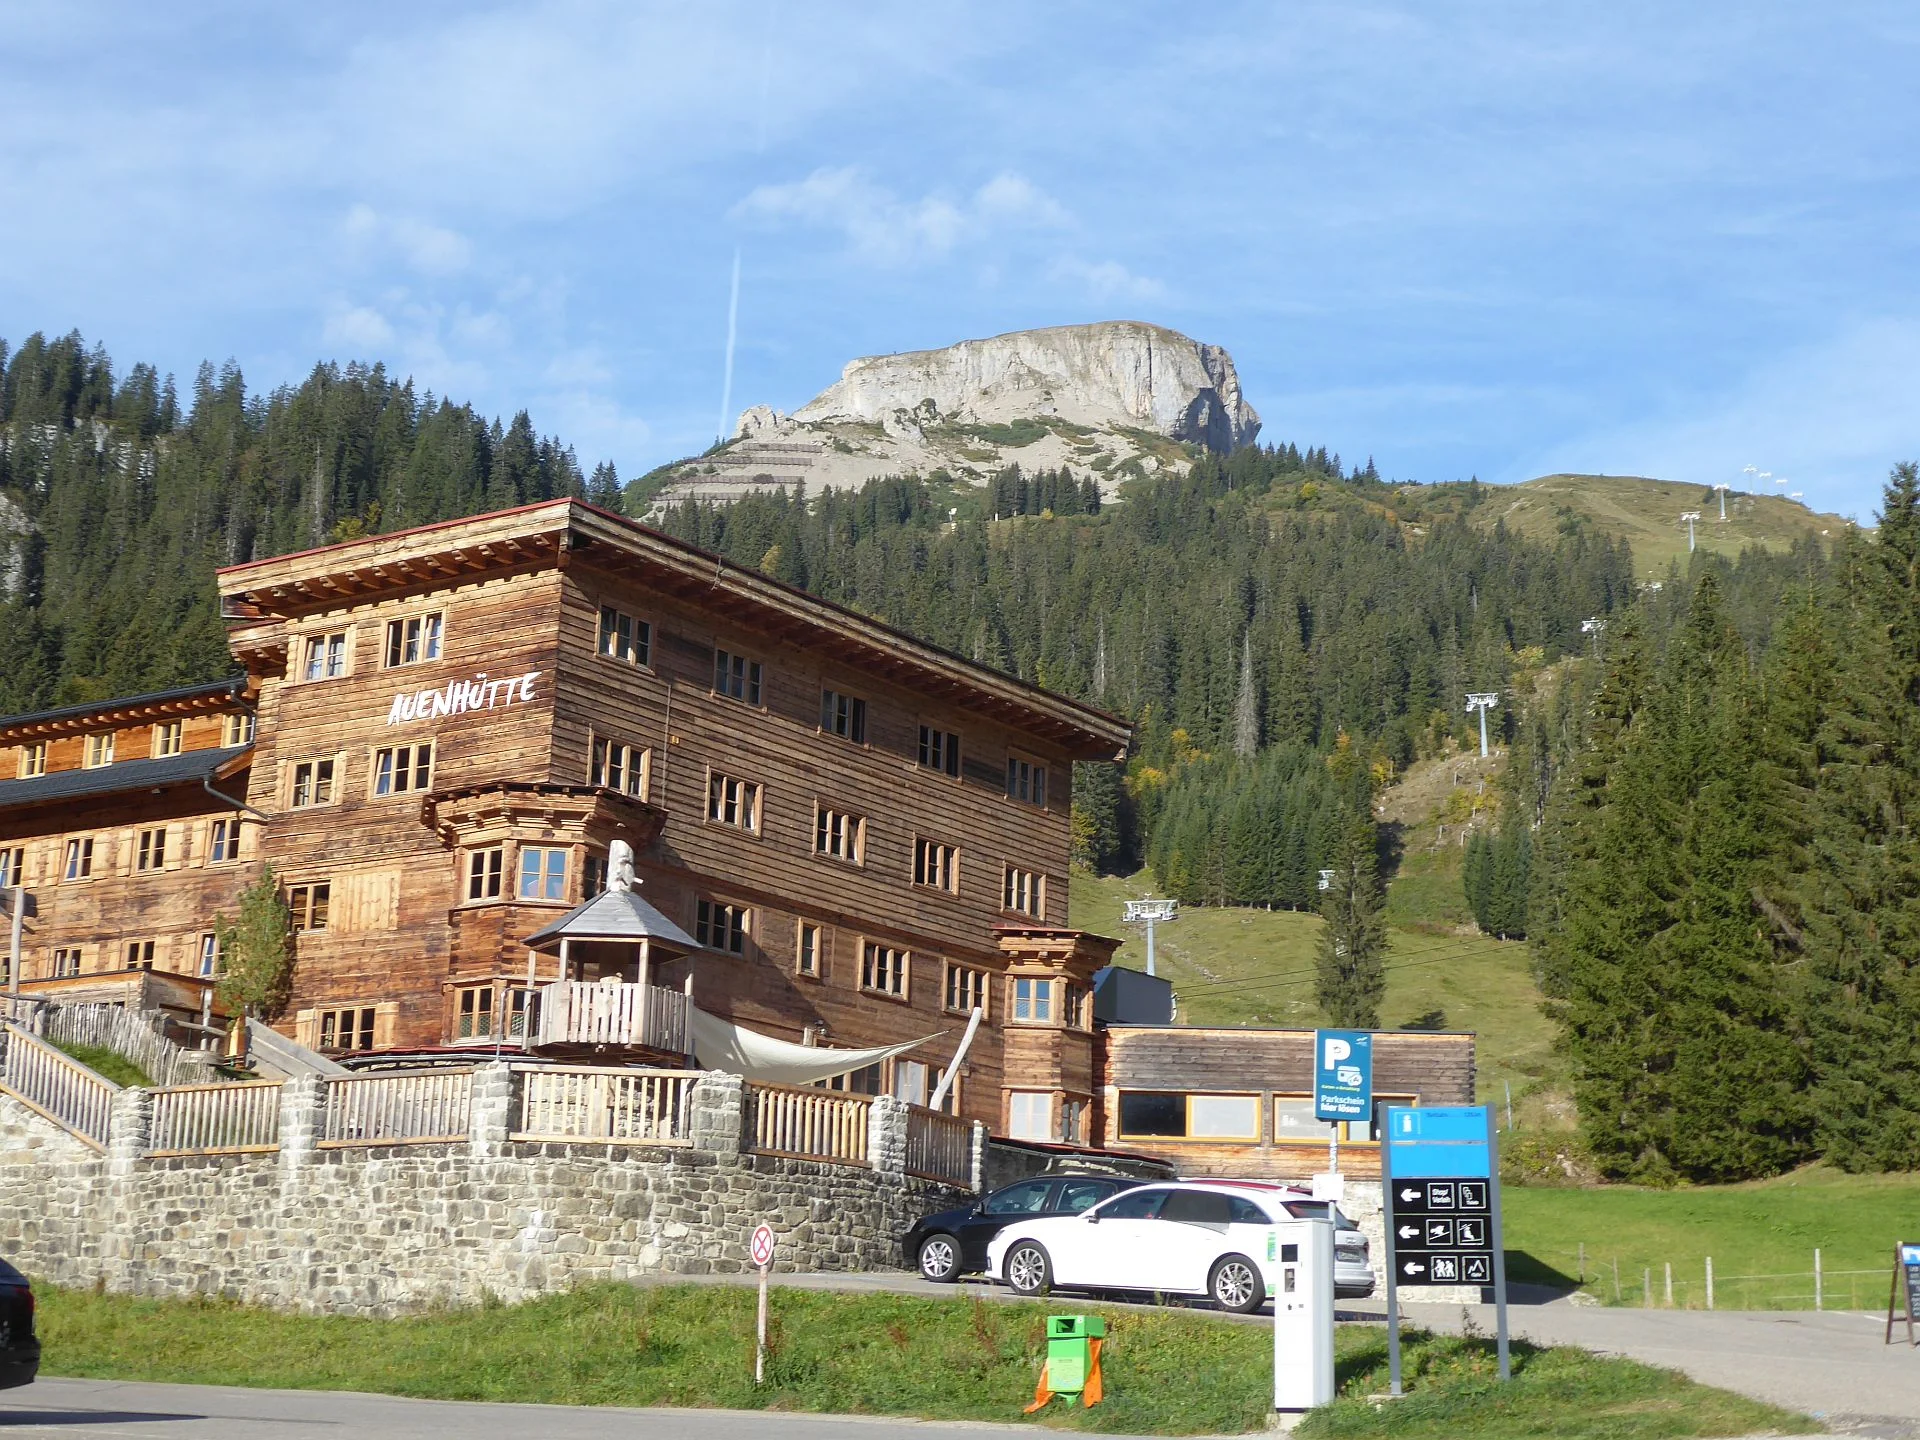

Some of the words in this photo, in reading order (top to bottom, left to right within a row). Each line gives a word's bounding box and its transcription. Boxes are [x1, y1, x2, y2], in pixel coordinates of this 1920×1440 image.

[387, 672, 542, 727] AUENHÜTTE
[1324, 1038, 1351, 1070] P
[1321, 1095, 1365, 1106] Parkschein
[1321, 1103, 1337, 1112] hier
[1338, 1104, 1360, 1114] lösen
